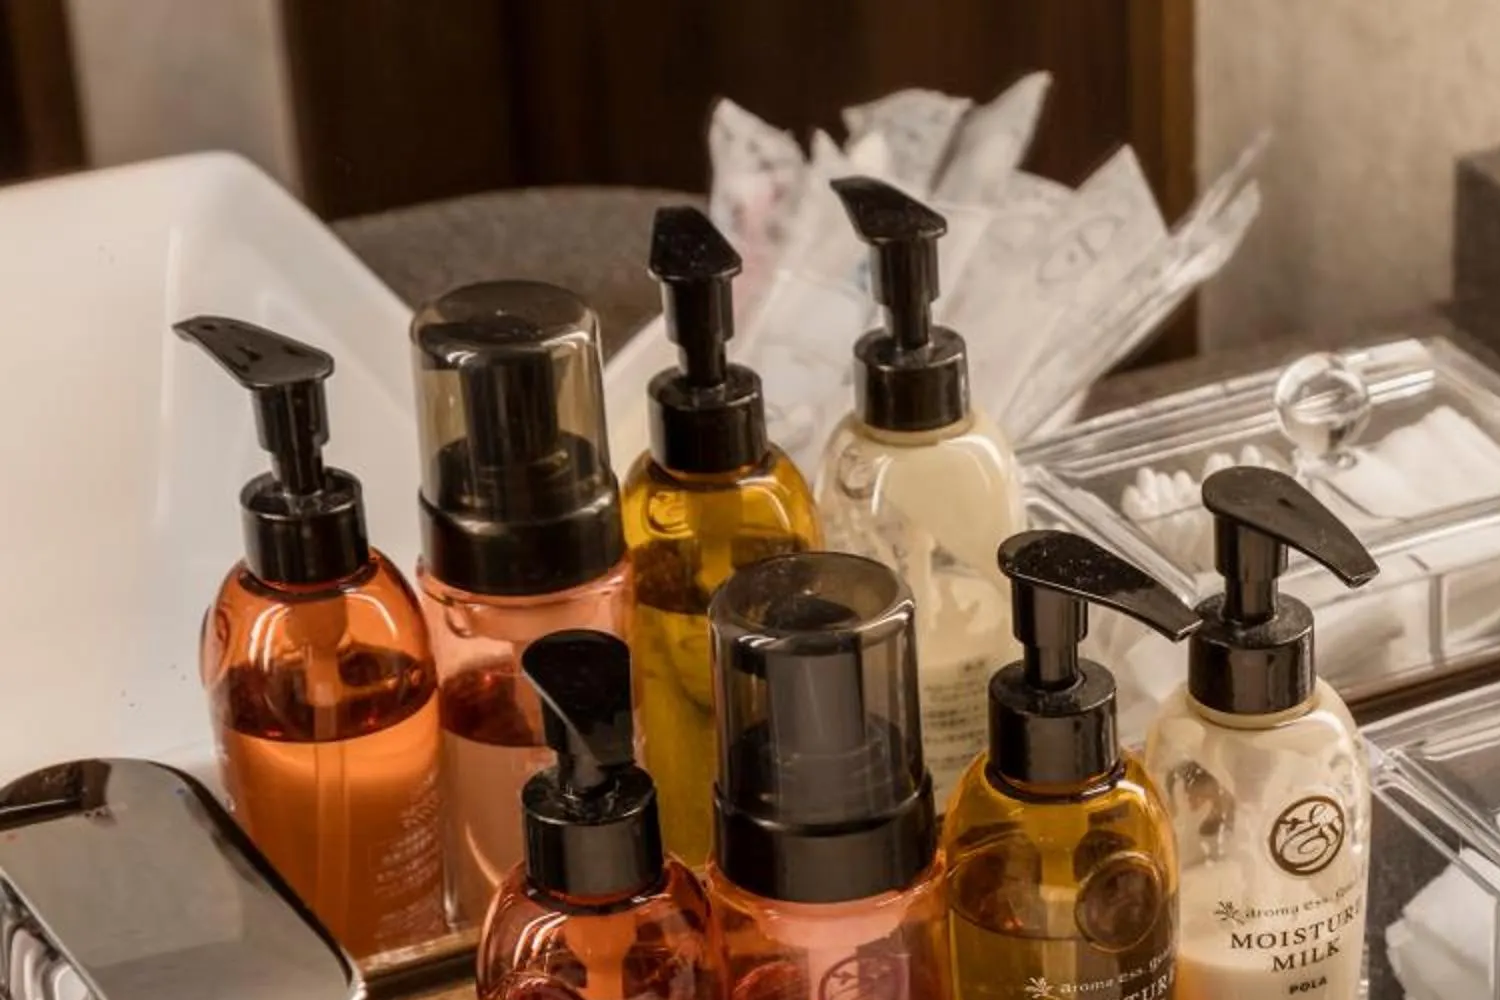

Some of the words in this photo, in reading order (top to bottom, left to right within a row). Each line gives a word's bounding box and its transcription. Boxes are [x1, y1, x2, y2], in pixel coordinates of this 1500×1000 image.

[1272, 937, 1341, 973] MILK
[1060, 977, 1114, 995] aroma
[1288, 975, 1328, 995] POLA
